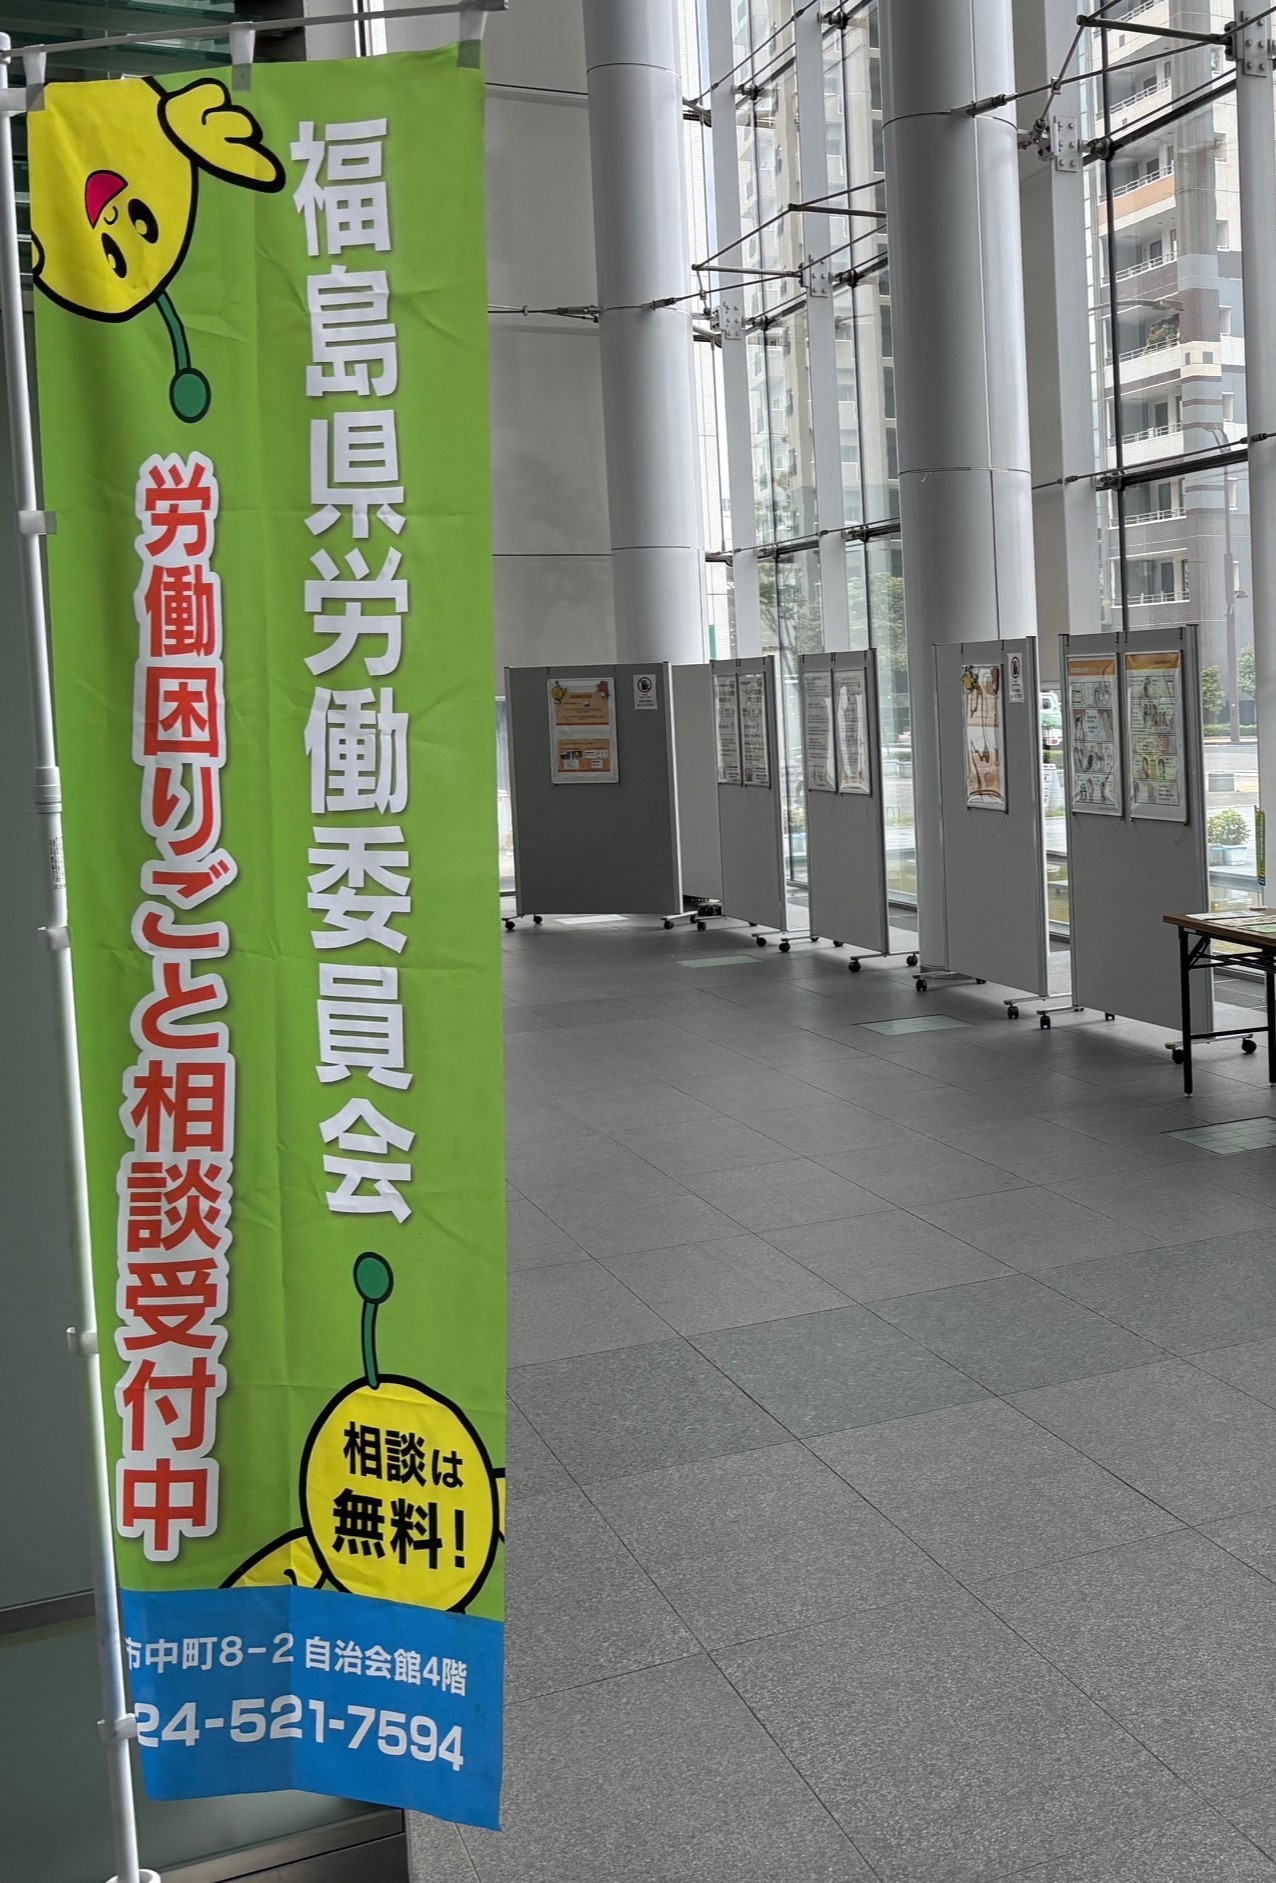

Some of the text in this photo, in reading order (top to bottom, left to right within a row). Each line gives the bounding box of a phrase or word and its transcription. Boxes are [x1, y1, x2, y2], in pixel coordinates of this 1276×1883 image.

[291, 118, 415, 1224] 福島県労働委員会
[120, 458, 233, 1556] 労働困りごと相談受付中
[343, 1421, 463, 1488] 相談は
[332, 1488, 465, 1570] 無料!
[305, 1635, 468, 1697] 自治会館4階
[134, 1694, 464, 1772] 24-521-7594
